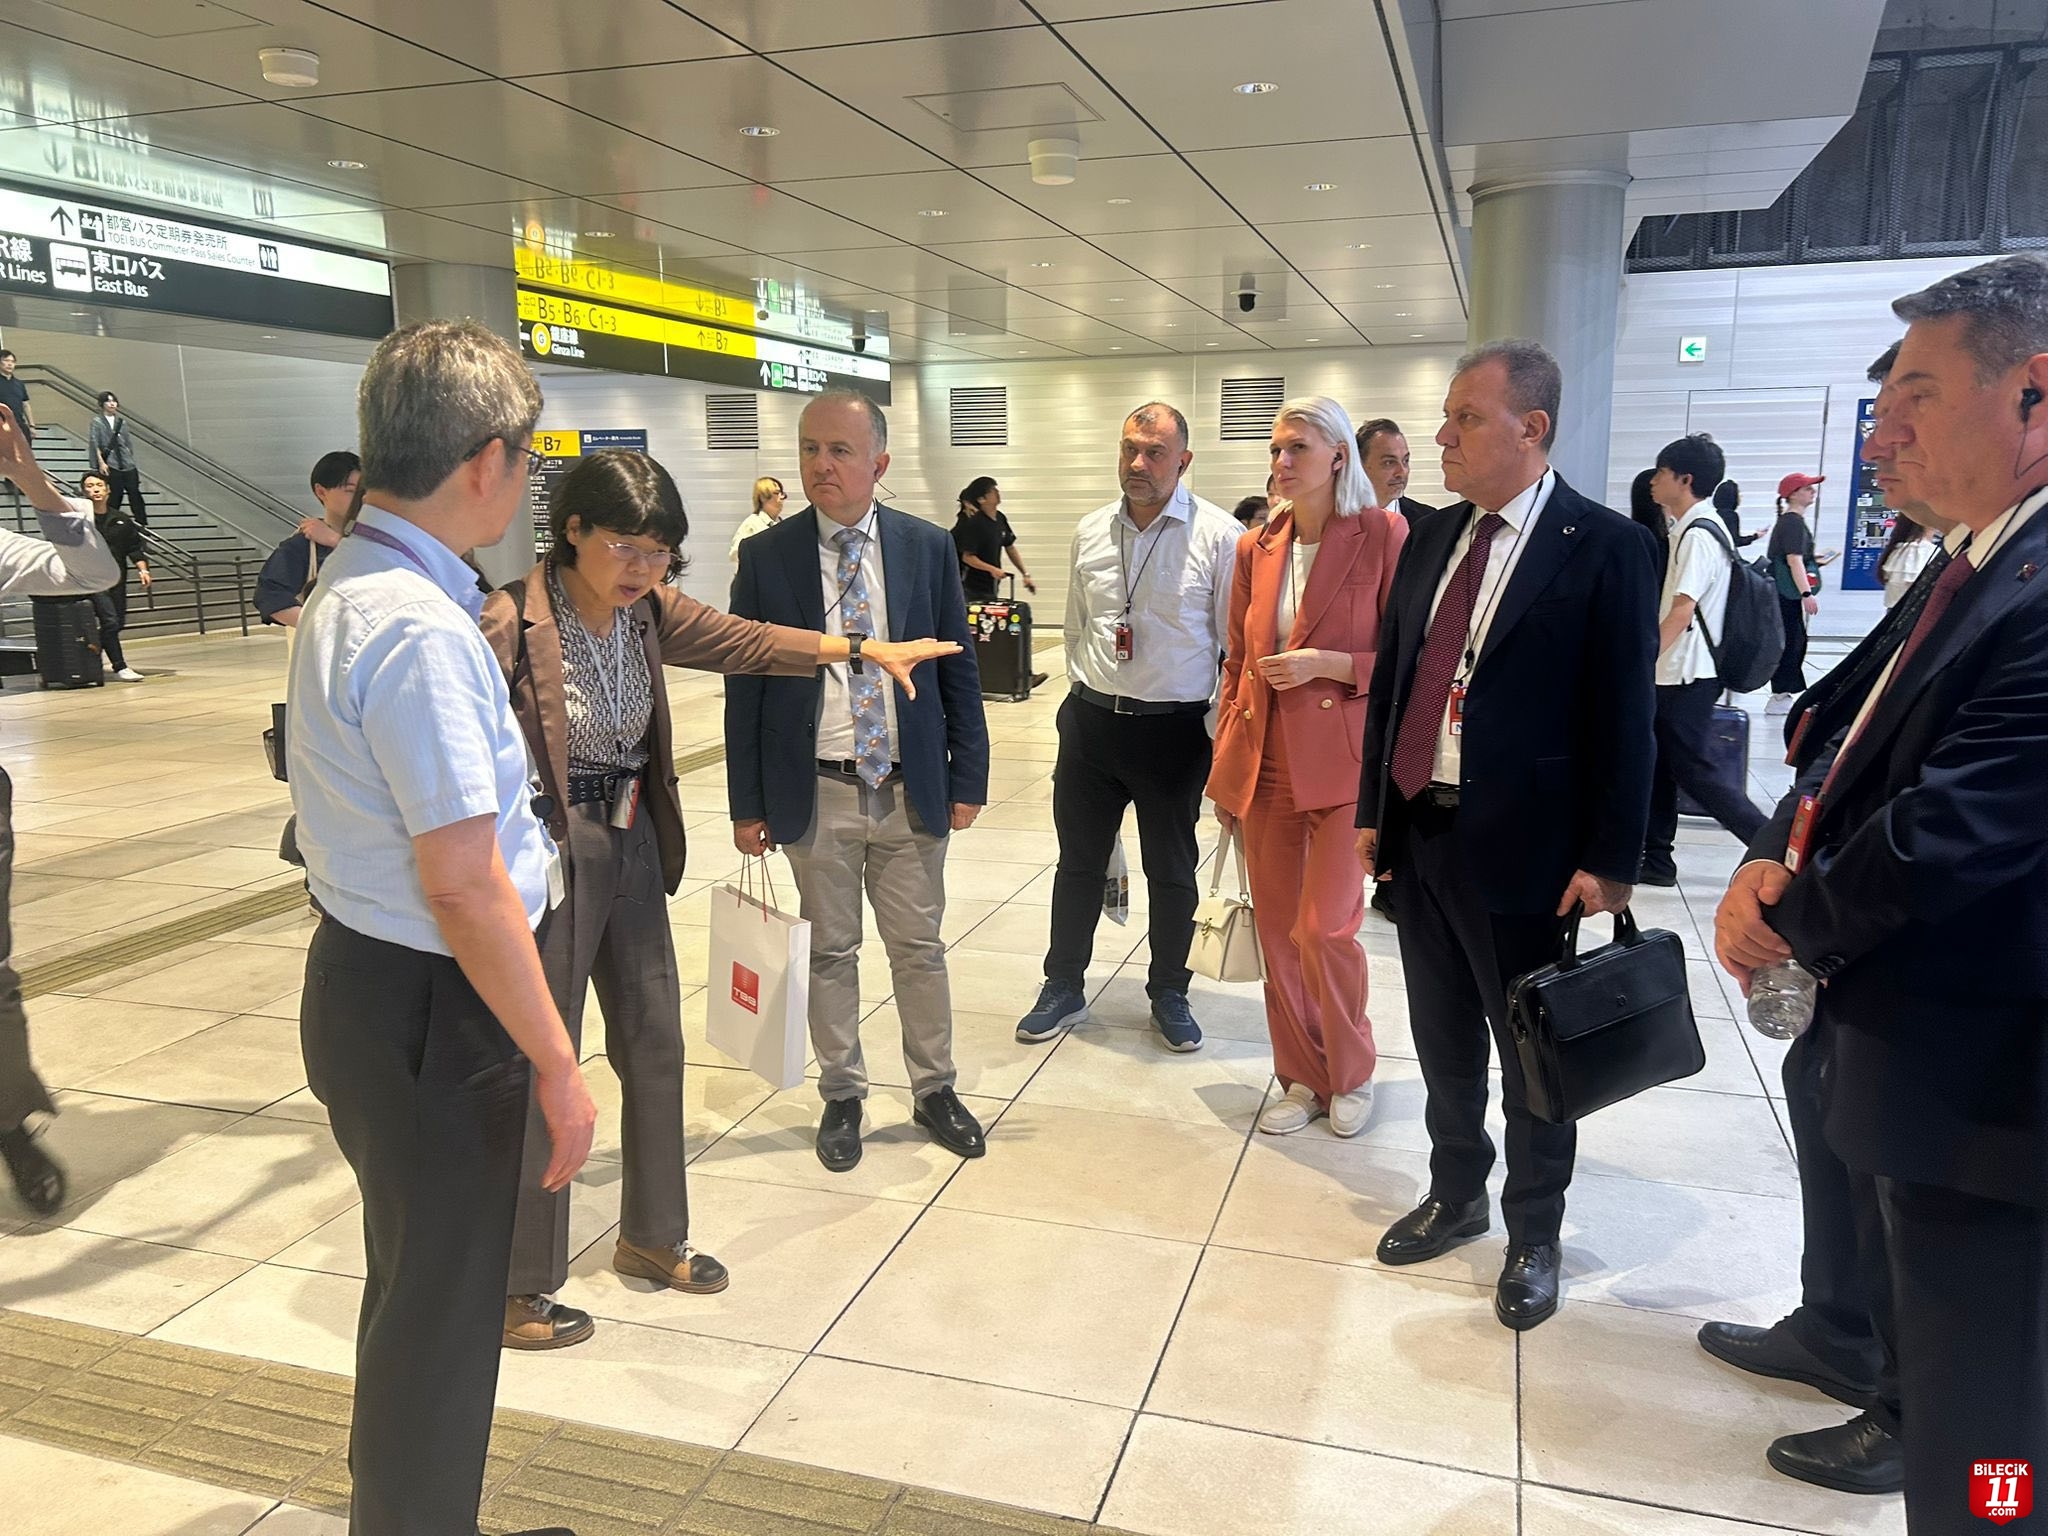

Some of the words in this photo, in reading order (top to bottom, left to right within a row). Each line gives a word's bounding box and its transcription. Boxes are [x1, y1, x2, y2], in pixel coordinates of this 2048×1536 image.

[108, 231, 128, 244] TOEI
[130, 236, 146, 248] BUS
[148, 239, 190, 255] Commuter
[191, 247, 207, 259] Pass
[207, 249, 226, 262] Sales
[227, 253, 255, 266] Counter
[8, 262, 47, 284] Lines
[91, 249, 166, 281] 東口バス
[94, 275, 123, 294] East
[124, 280, 149, 298] Bus
[716, 332, 728, 351] B7
[543, 436, 561, 451] B7
